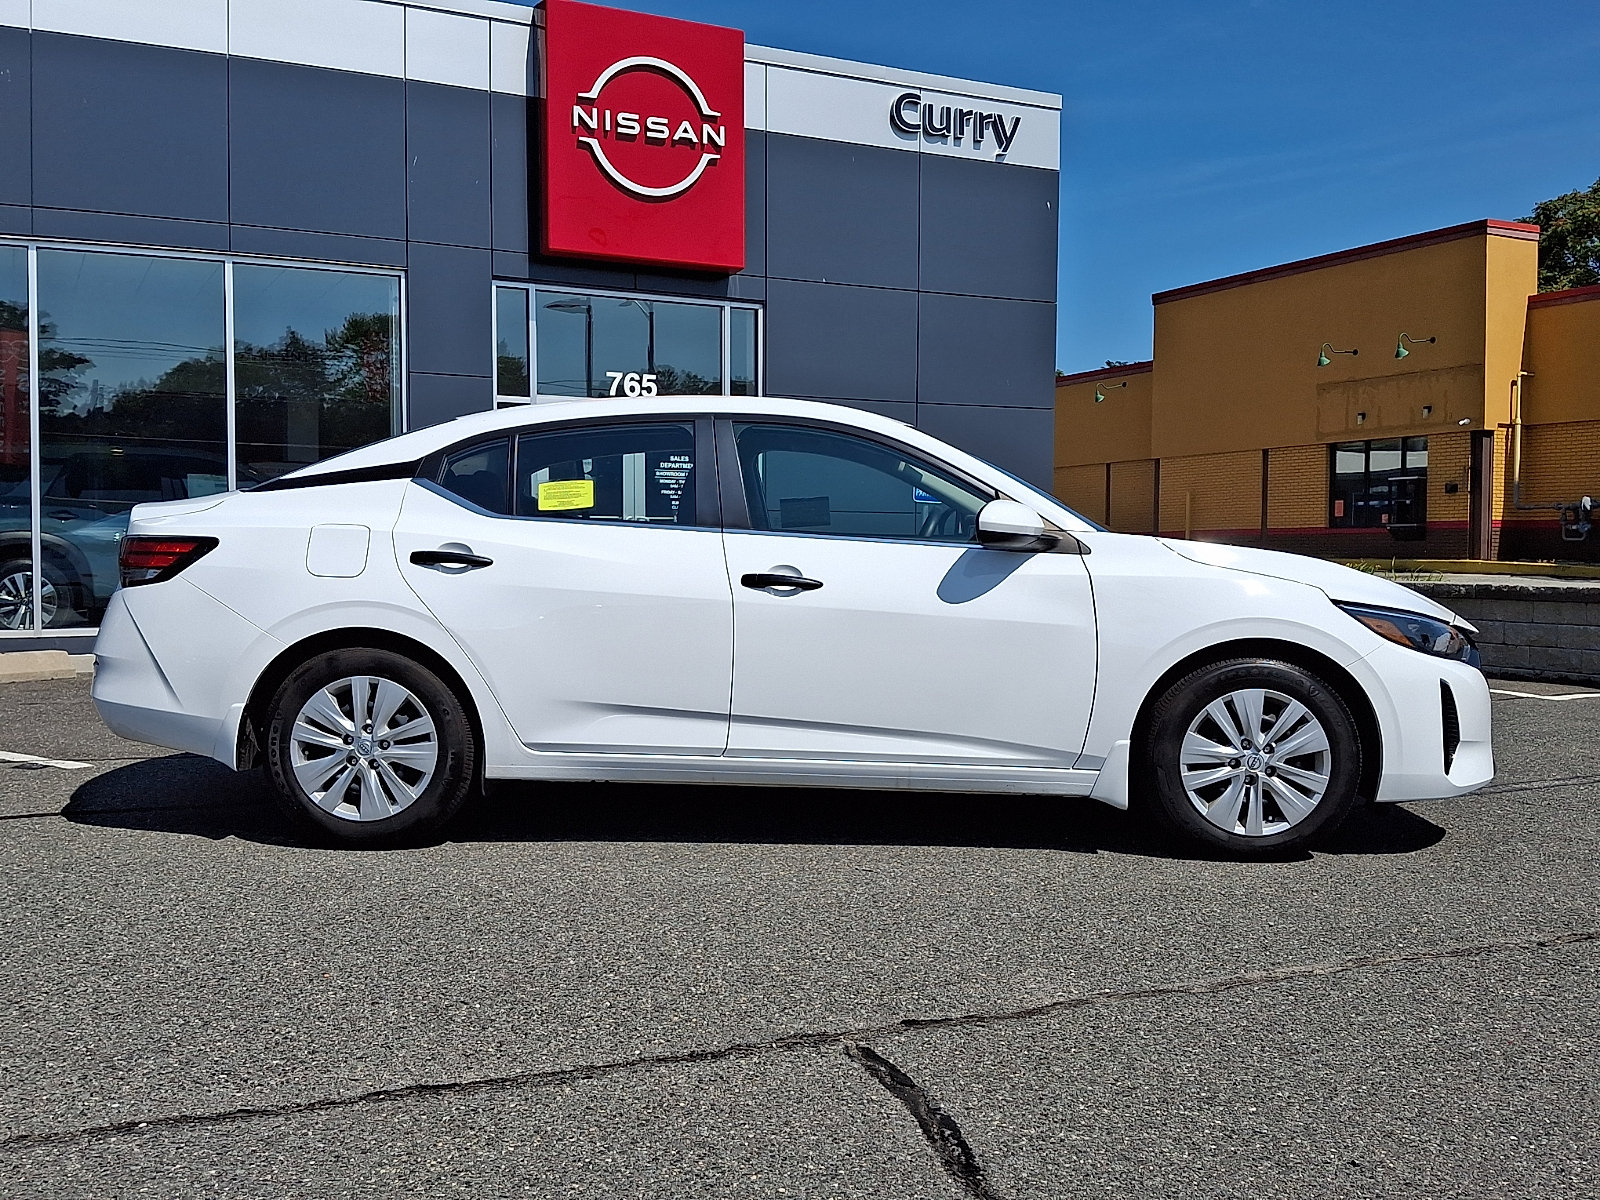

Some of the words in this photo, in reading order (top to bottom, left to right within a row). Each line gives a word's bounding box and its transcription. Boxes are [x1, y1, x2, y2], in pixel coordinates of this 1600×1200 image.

[572, 105, 725, 146] NISSAN
[893, 92, 1021, 153] Curry
[606, 371, 658, 397] 765
